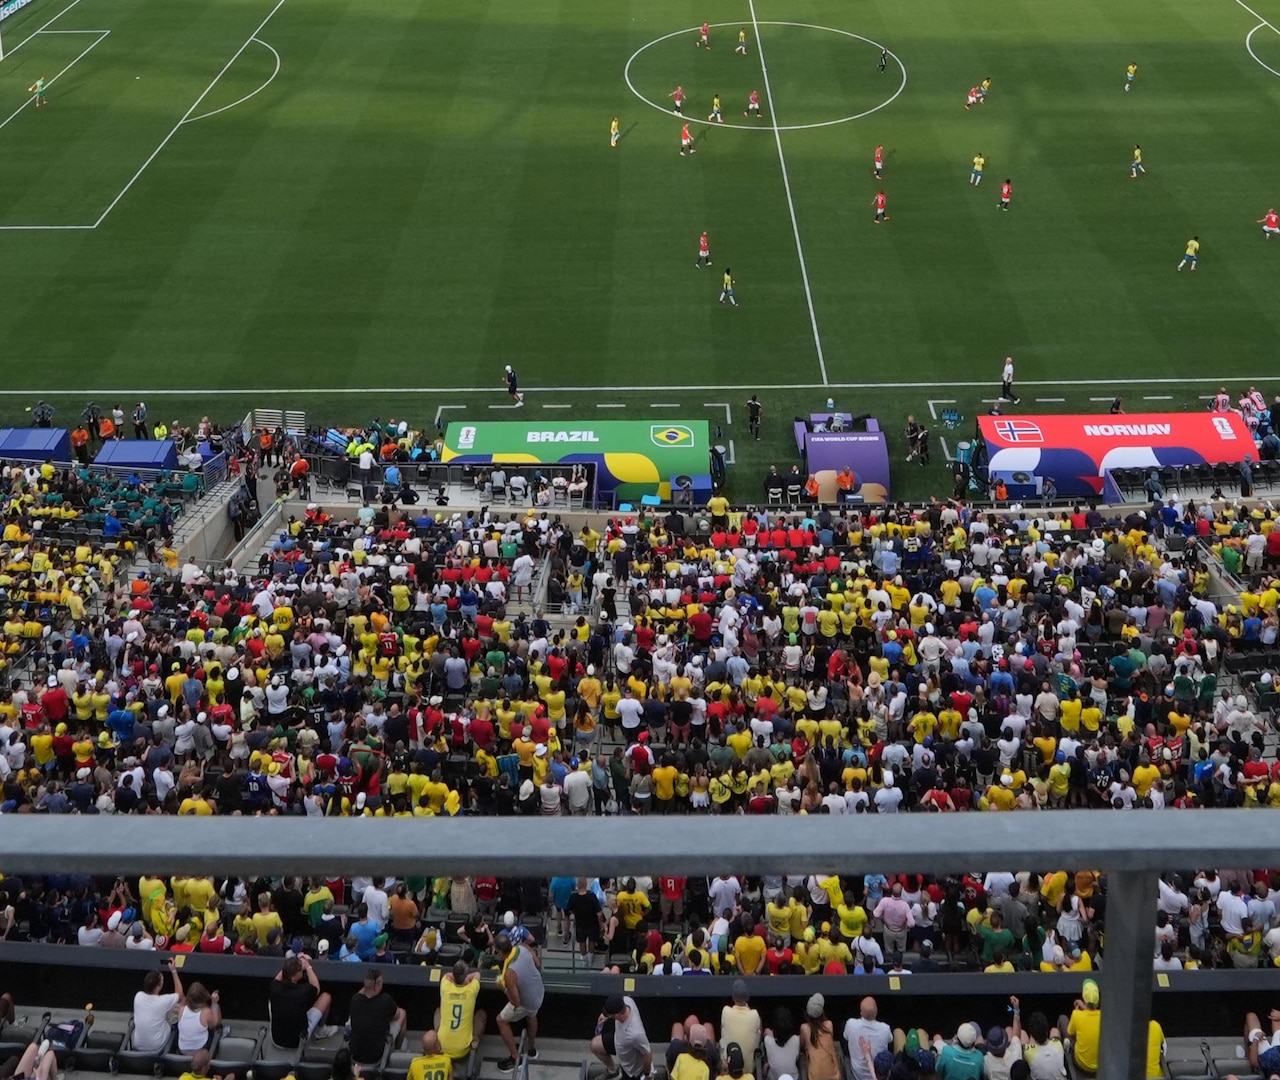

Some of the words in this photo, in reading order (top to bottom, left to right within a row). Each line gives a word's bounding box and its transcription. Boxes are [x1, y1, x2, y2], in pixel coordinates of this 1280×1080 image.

[527, 430, 600, 443] BRAZIL
[1083, 423, 1171, 437] NORWAY
[450, 1003, 462, 1031] 9
